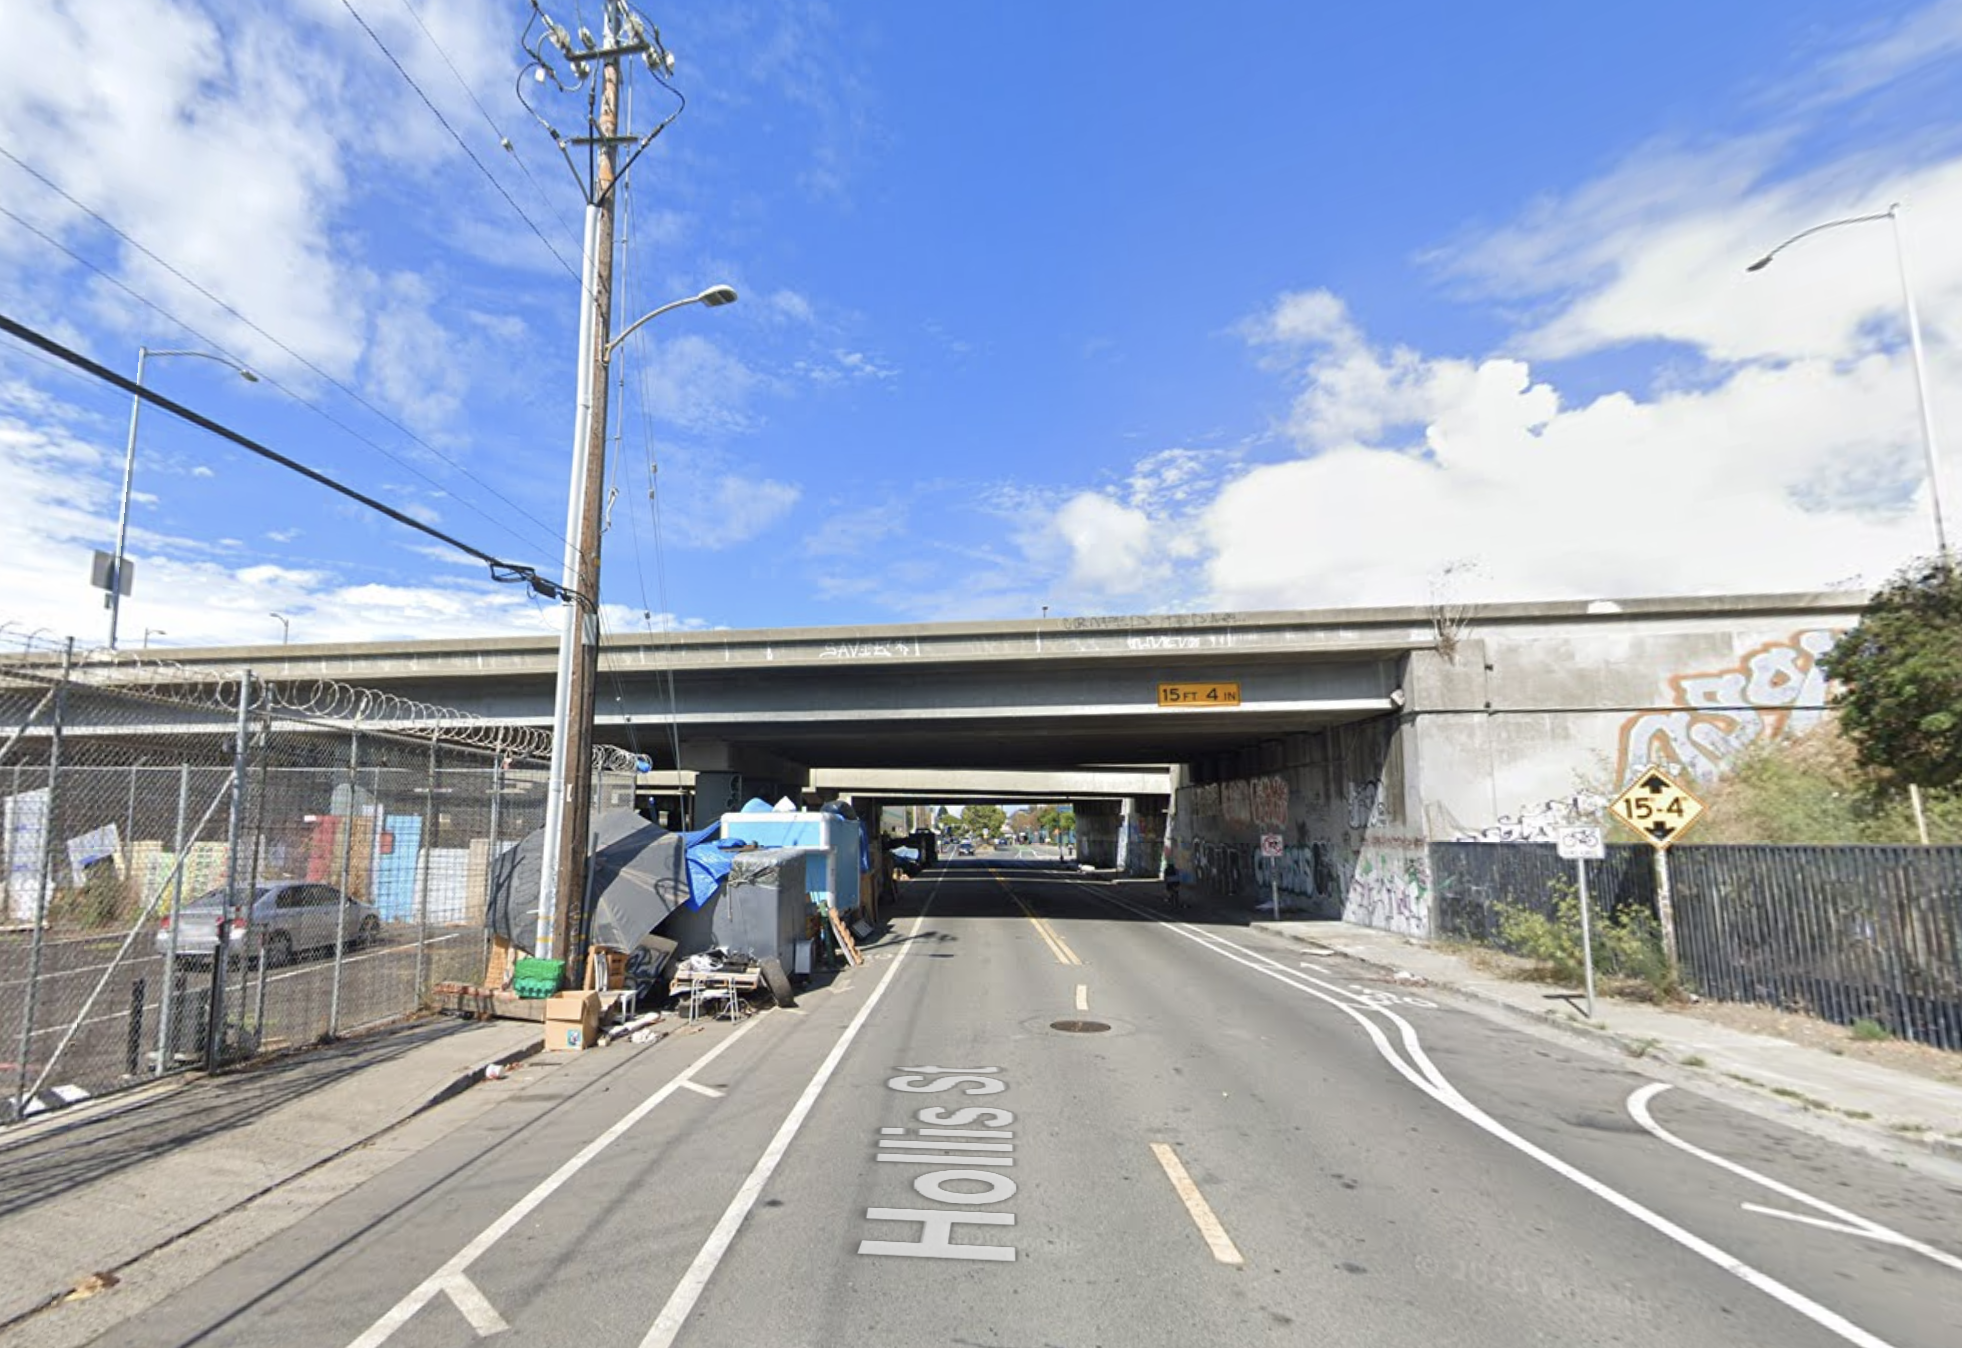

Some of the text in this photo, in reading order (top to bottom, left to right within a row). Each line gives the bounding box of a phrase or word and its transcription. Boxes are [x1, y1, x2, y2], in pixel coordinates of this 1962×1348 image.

[1163, 687, 1237, 702] 15 FT 4 IN
[1624, 796, 1684, 820] 15-4
